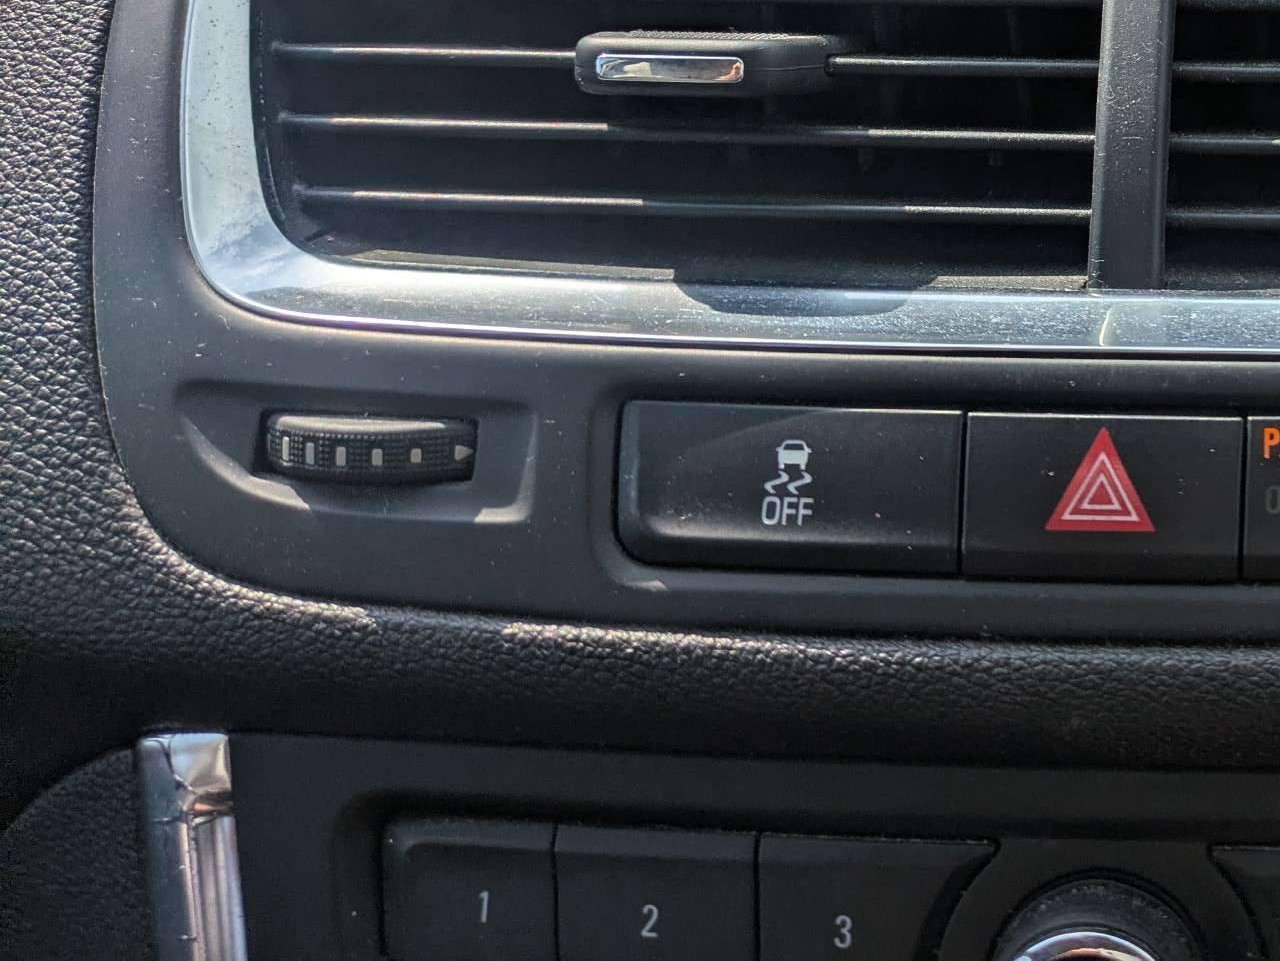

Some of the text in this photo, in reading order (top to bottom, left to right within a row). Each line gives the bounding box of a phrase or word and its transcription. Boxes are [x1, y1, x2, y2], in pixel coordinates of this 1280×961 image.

[761, 495, 815, 526] OFF
[477, 890, 490, 924] 1
[641, 904, 660, 938] 2
[834, 915, 853, 948] 3
